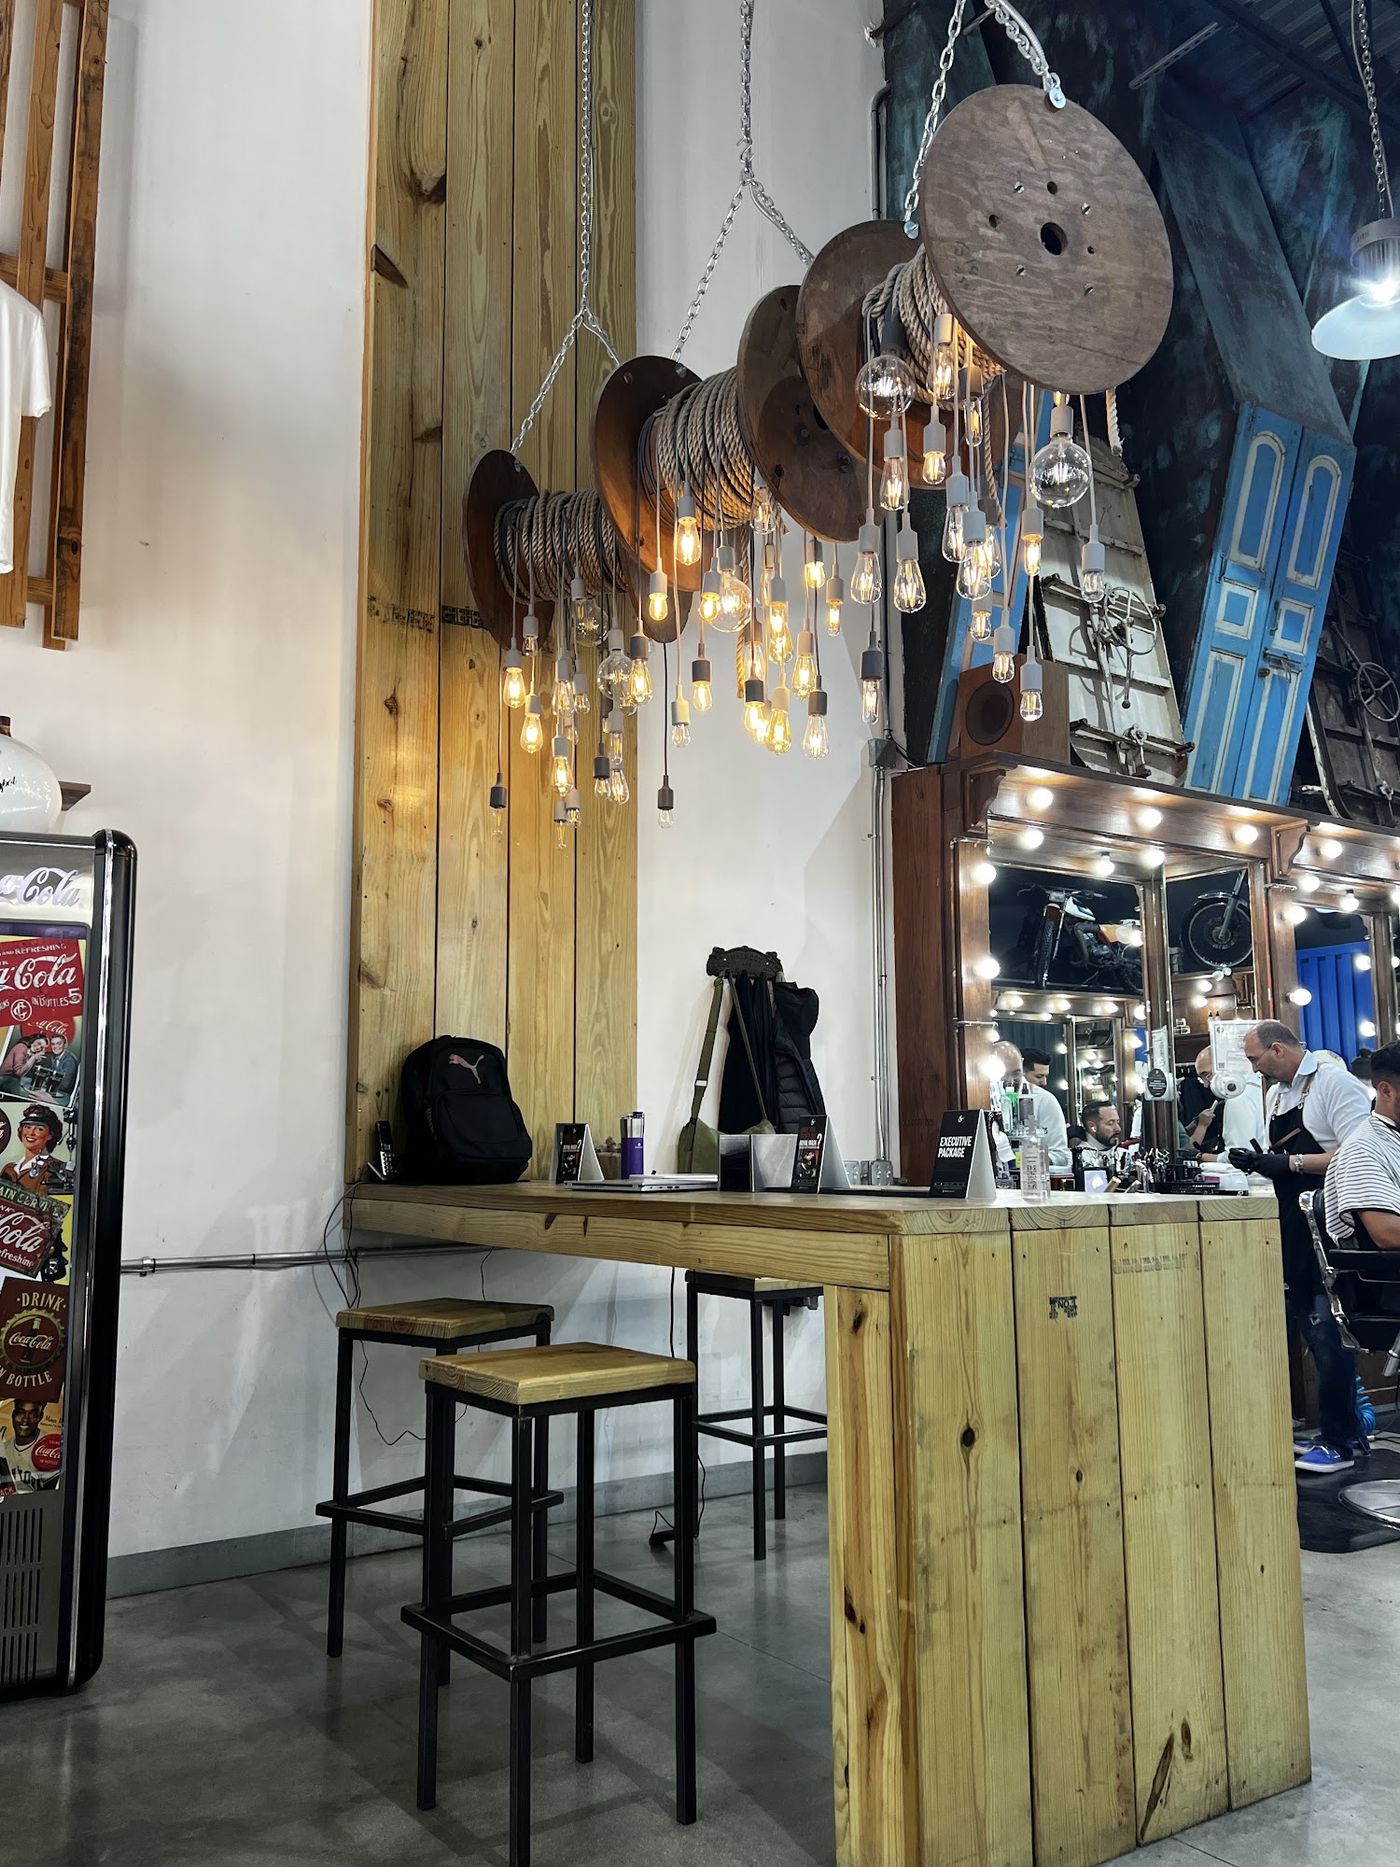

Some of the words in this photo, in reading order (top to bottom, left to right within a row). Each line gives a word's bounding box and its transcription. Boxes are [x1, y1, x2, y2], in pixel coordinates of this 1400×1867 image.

[939, 1136, 973, 1147] EXECUTIVE
[937, 1147, 966, 1158] PACKAGE
[22, 1292, 64, 1312] DRINK
[8, 1331, 54, 1350] Coca-Cola
[6, 1370, 53, 1388] BOTTLE
